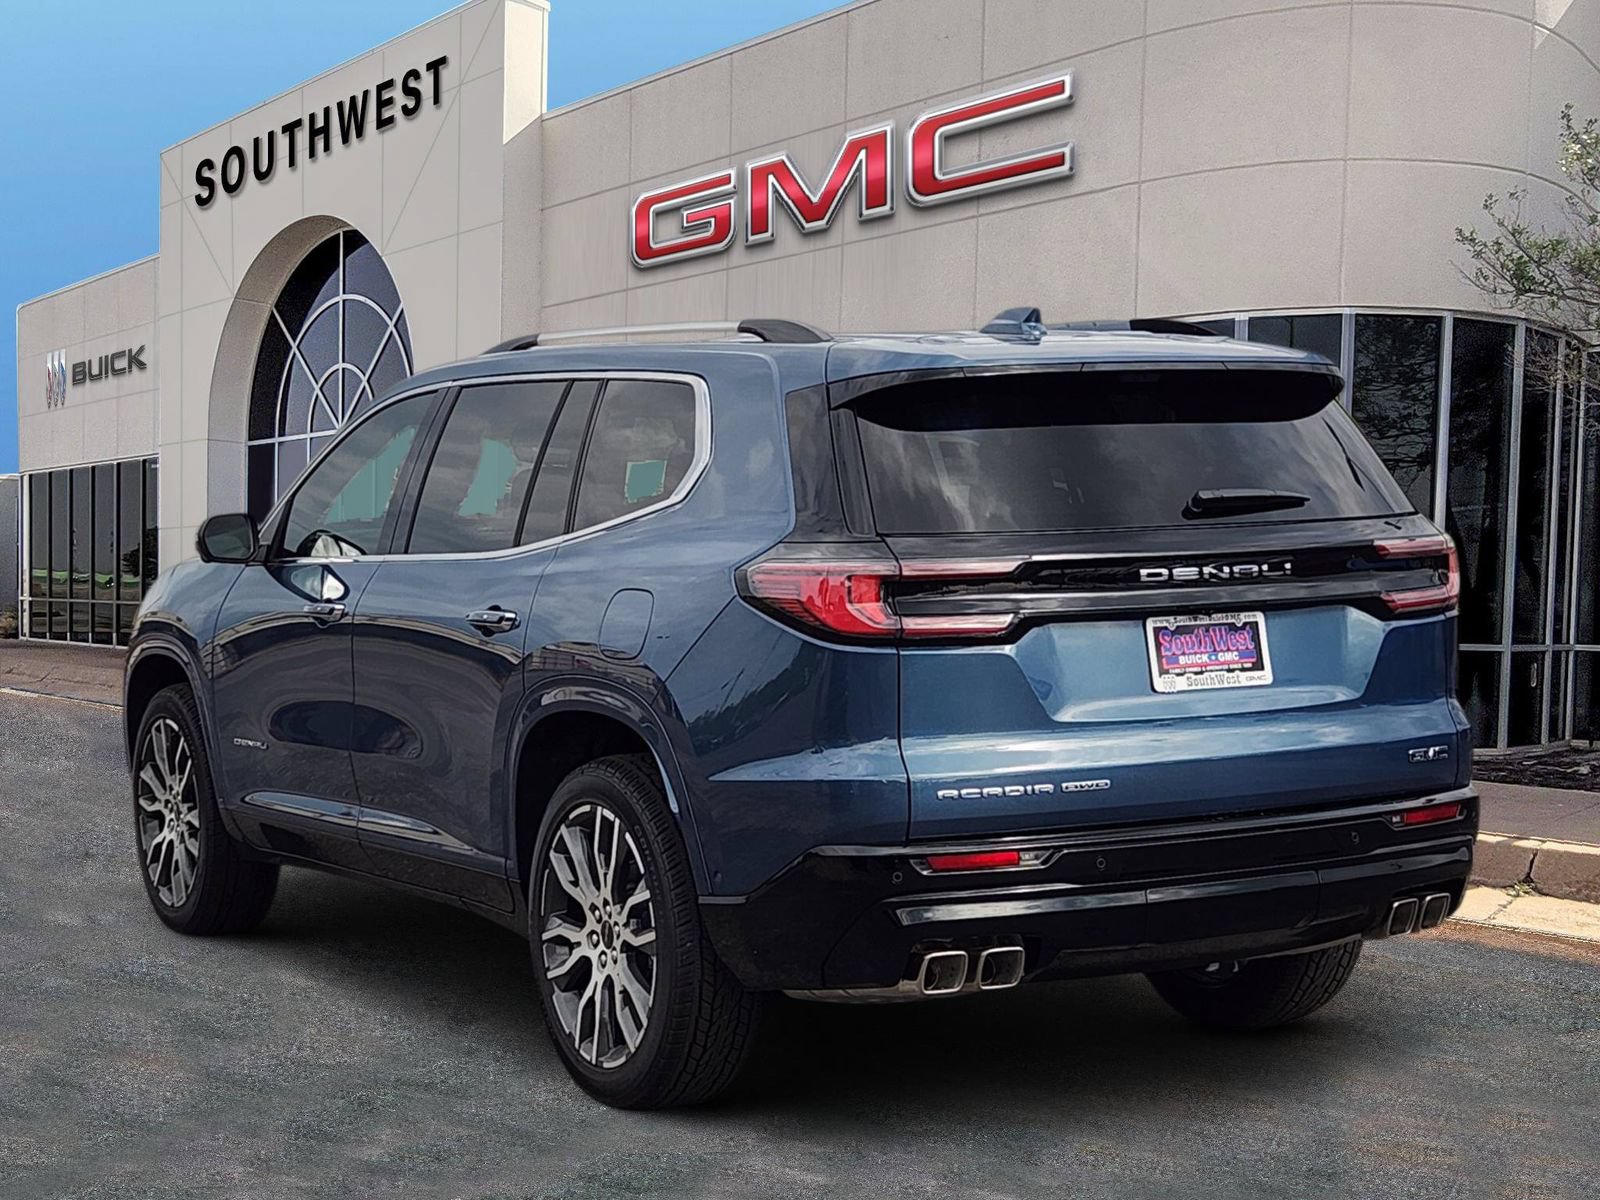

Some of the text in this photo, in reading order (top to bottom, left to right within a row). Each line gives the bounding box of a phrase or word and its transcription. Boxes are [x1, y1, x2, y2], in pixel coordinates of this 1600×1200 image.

[194, 56, 449, 207] SOUTHWEST
[630, 69, 1075, 268] GMC
[72, 344, 147, 386] BUICK
[1139, 562, 1292, 582] DENALI
[1158, 625, 1255, 656] SouthWest
[1178, 651, 1240, 665] BUICK GMC
[1186, 674, 1242, 688] SouthWest
[937, 779, 1111, 800] ACADIA AWD
